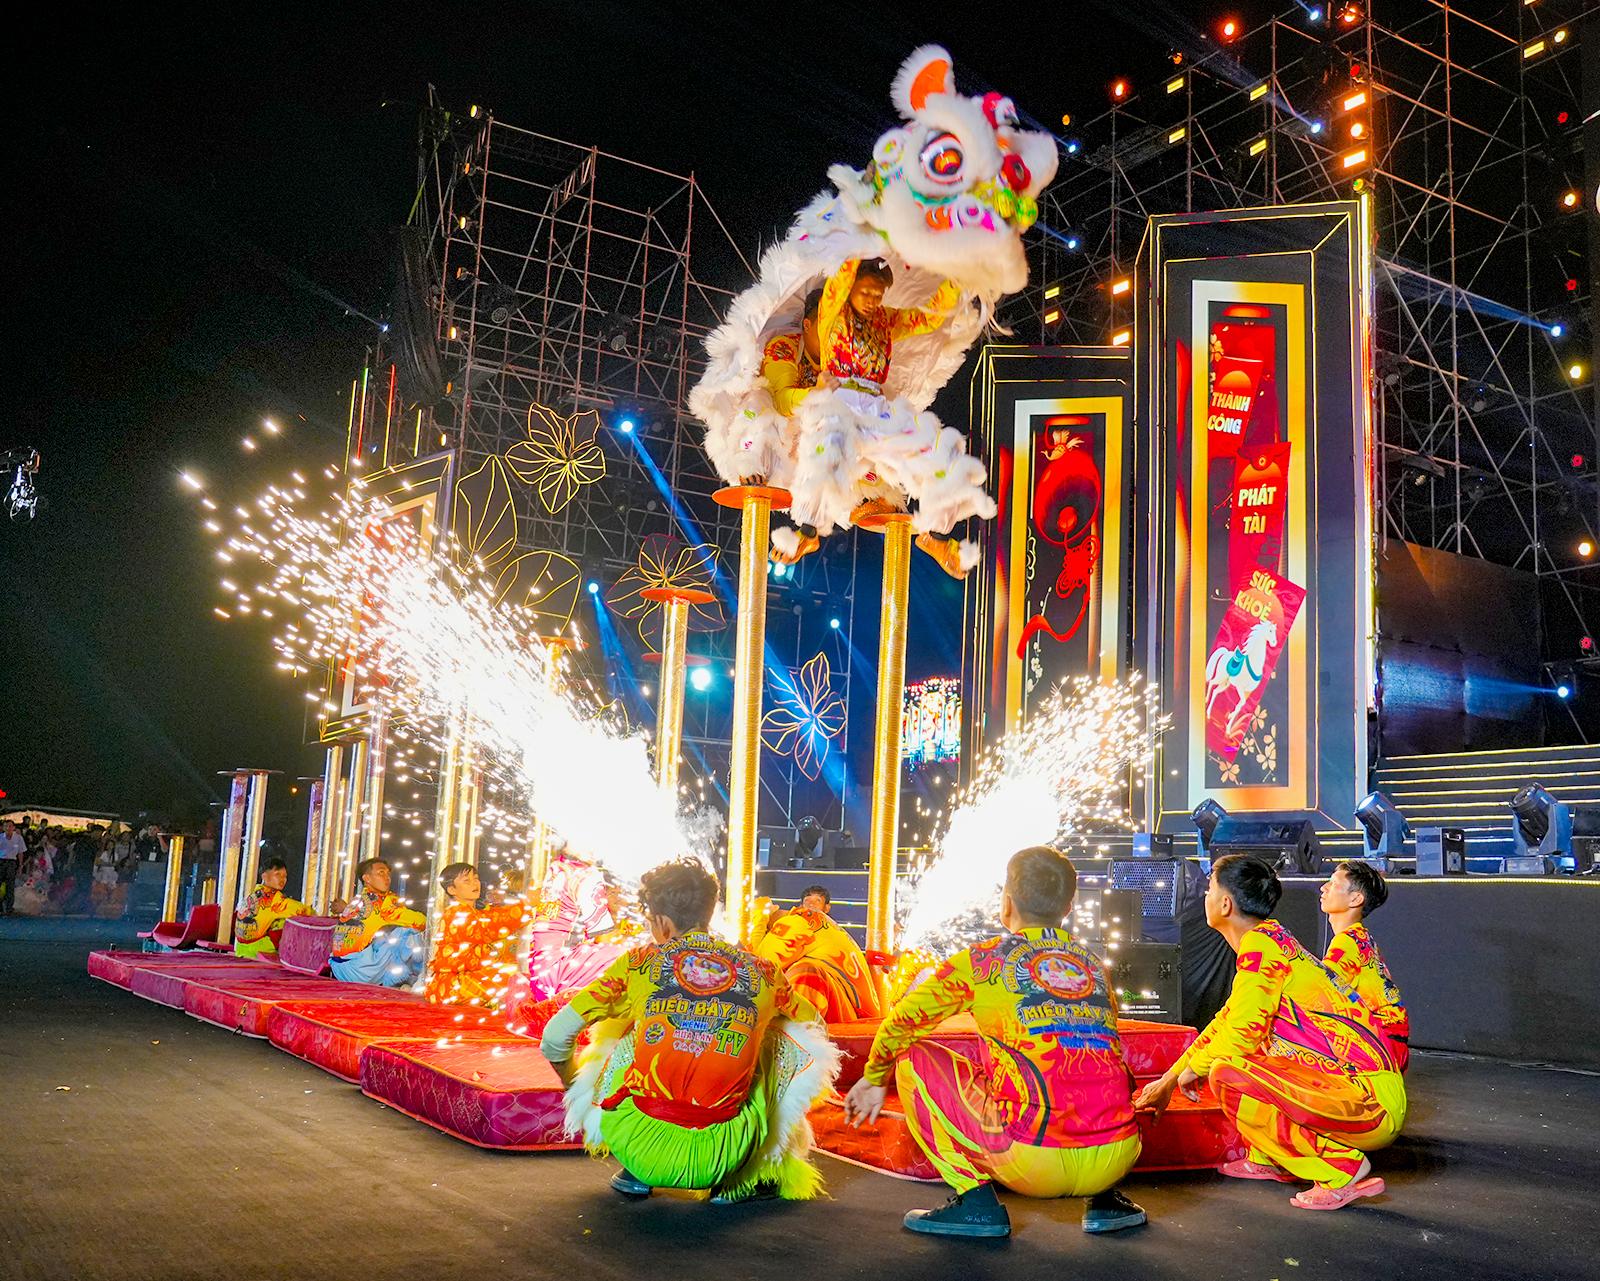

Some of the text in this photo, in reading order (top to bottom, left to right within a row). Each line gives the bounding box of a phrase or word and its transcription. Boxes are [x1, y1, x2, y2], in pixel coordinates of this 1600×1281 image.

[1211, 391, 1251, 412] THÀNH
[1207, 416, 1242, 434] CÔNG
[1238, 484, 1277, 507] PHÁT
[1243, 514, 1266, 535] TÀI
[715, 1028, 749, 1058] TV
